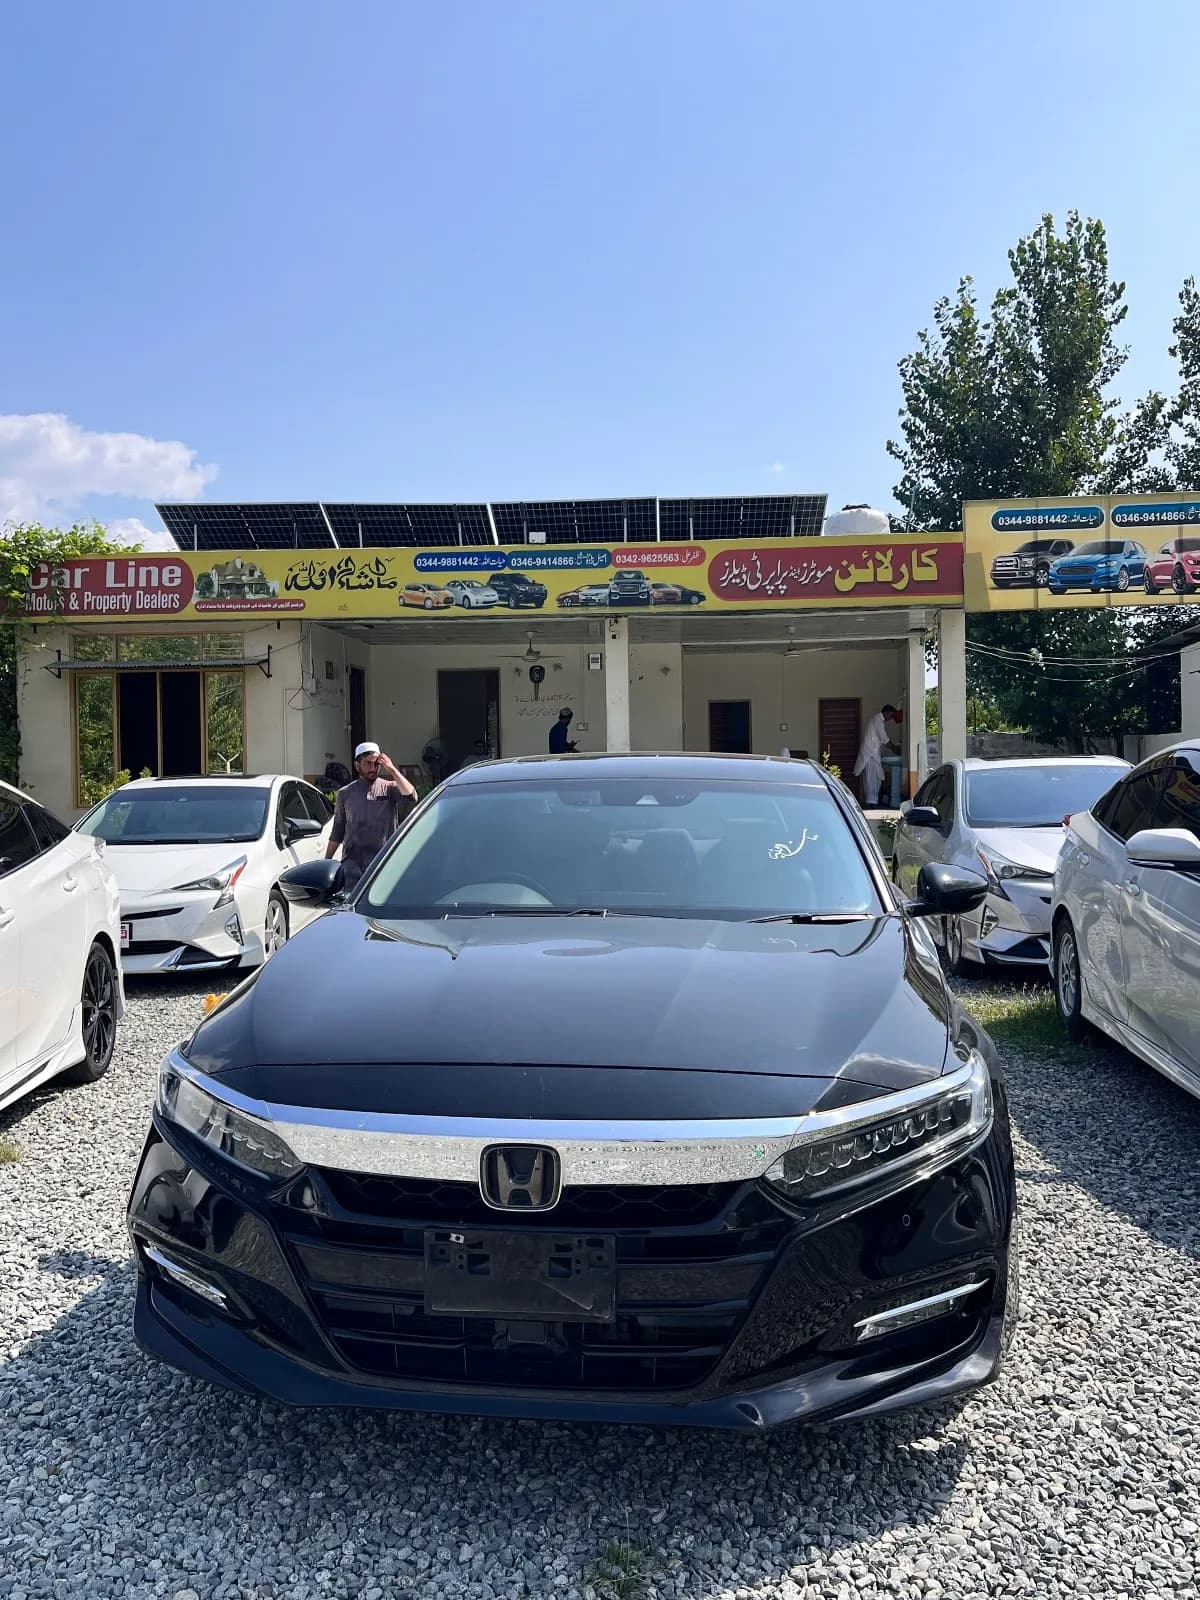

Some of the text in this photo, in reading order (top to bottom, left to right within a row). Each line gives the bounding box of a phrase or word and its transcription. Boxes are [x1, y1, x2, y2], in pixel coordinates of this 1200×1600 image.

[998, 514, 1068, 526] 0344-9881442
[1115, 511, 1185, 523] 0346-9414866
[416, 557, 478, 567] 0344-9881442
[511, 556, 574, 567] 0346-9414866
[105, 560, 182, 588] Line
[69, 591, 79, 610] &
[84, 591, 133, 614] Property
[135, 589, 180, 609] Dealers
